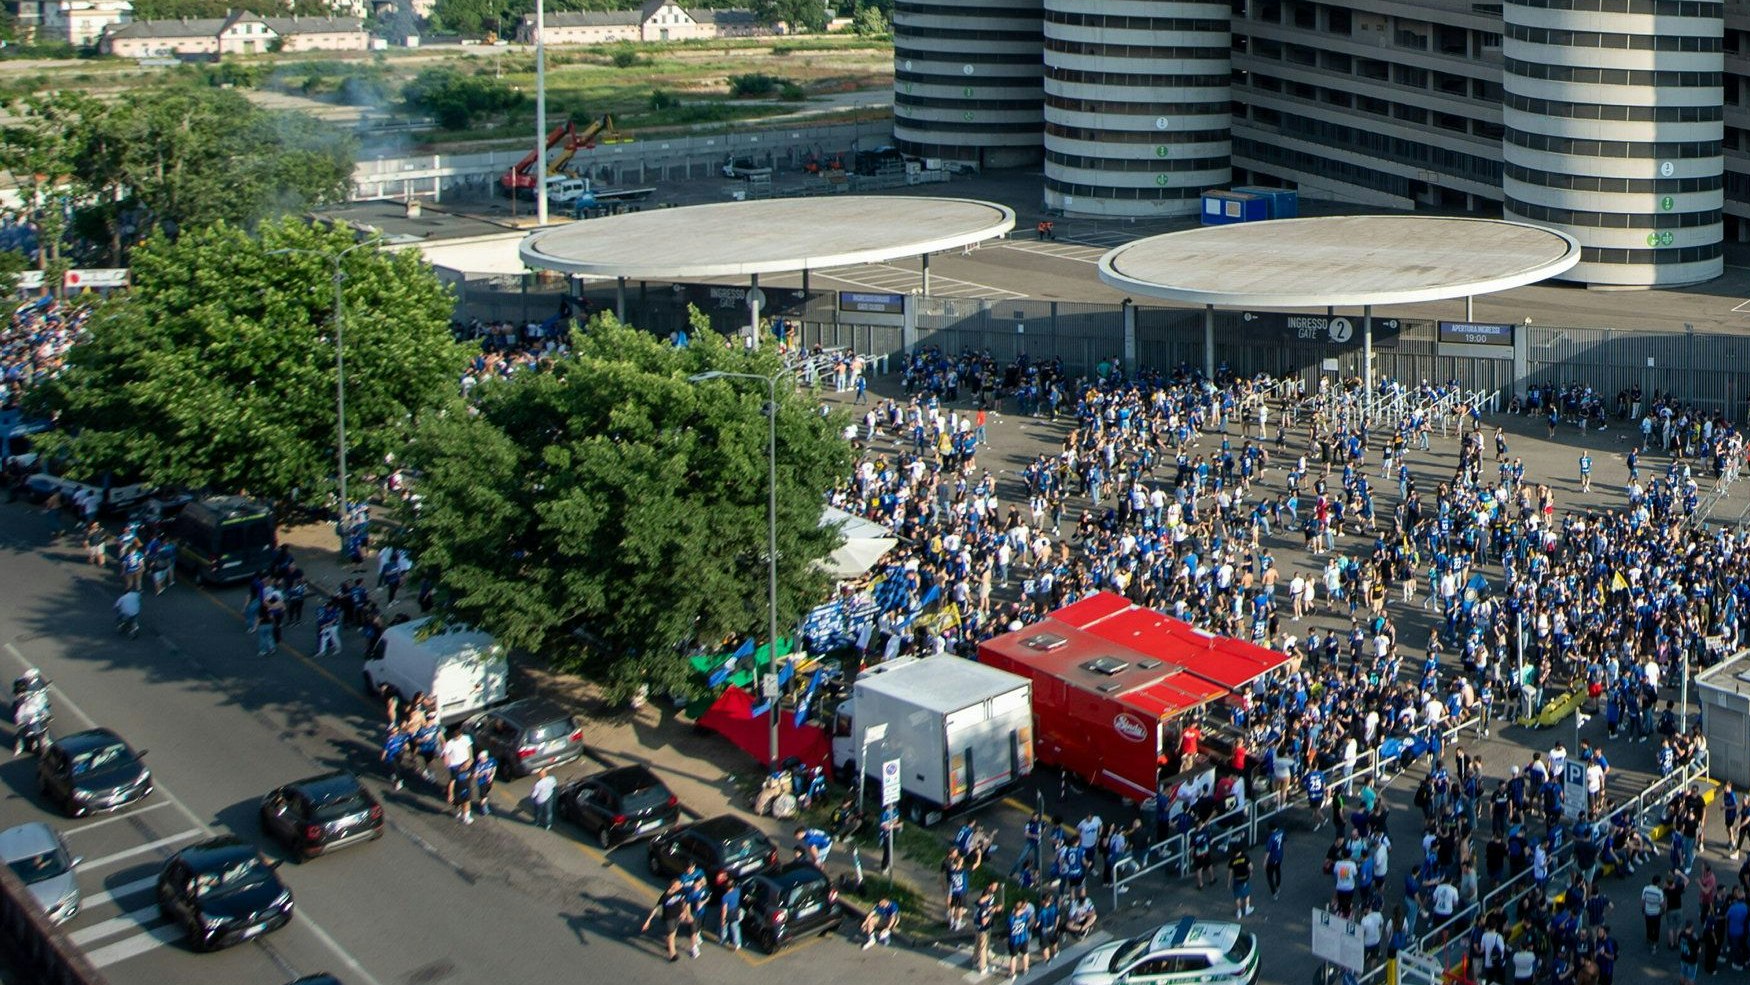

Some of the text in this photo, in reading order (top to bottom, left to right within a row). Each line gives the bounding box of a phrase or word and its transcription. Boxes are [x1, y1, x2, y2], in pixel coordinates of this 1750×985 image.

[1287, 316, 1328, 330] INGRESSO
[1337, 320, 1346, 339] 2
[1298, 328, 1317, 340] GATE
[1465, 333, 1487, 343] 19:00
[1569, 764, 1580, 783] P
